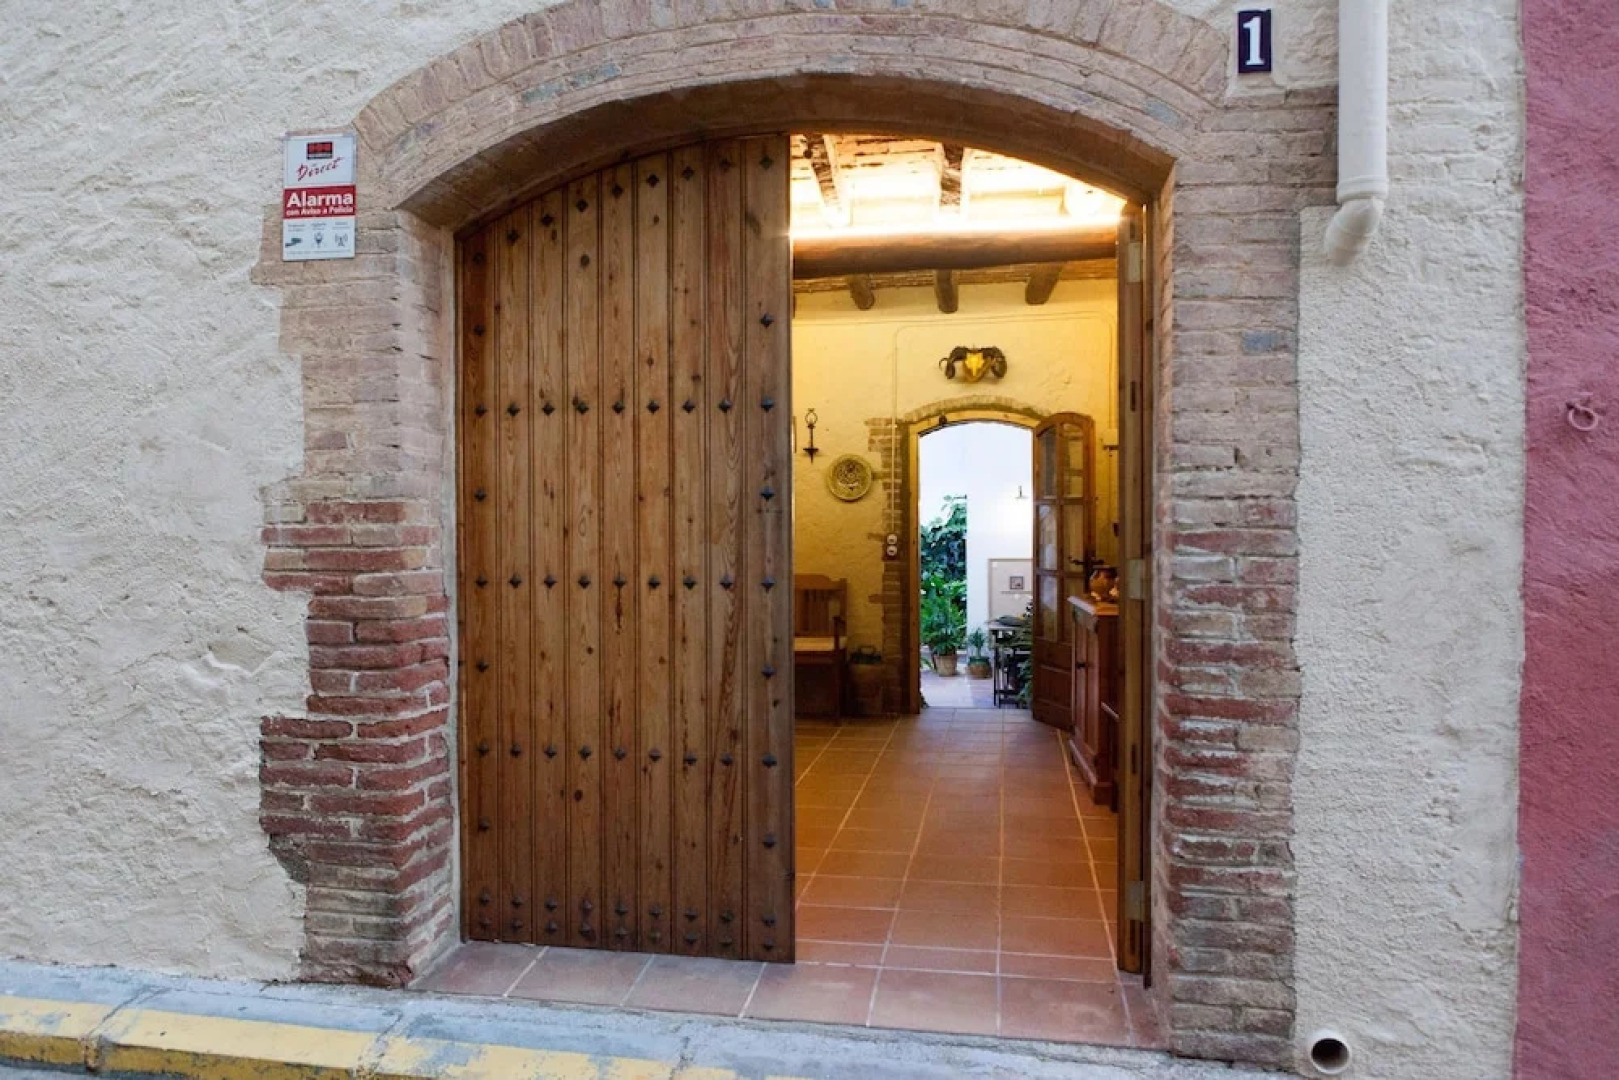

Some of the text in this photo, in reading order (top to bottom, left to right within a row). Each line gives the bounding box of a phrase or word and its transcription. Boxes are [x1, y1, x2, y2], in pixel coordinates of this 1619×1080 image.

[1242, 15, 1265, 66] 1
[296, 156, 345, 182] Direct
[286, 191, 354, 208] Alarma
